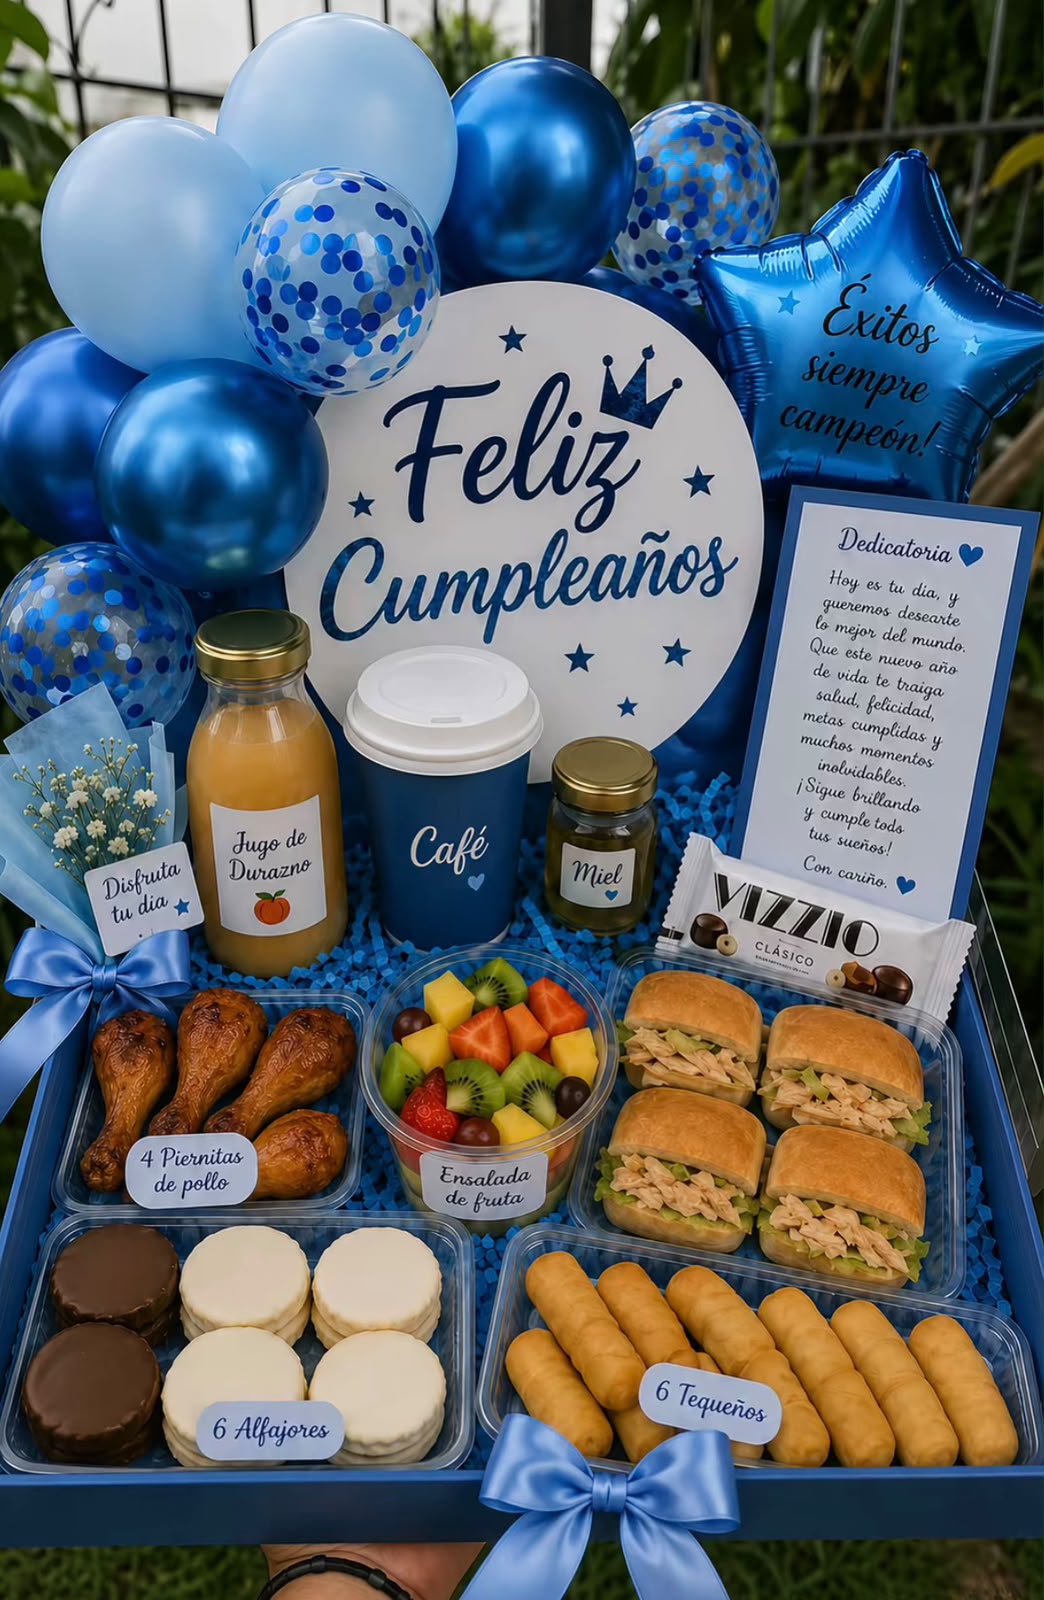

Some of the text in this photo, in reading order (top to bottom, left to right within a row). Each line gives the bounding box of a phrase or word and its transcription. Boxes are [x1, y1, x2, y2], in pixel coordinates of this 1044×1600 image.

[823, 273, 940, 354] Éxitos
[801, 351, 930, 410] siempre
[780, 404, 942, 457] campeón!
[382, 372, 641, 533] Feliz
[838, 526, 952, 563] Dedicatoria
[319, 528, 739, 644] Cumpleaños
[829, 569, 860, 594] Hoy
[866, 580, 882, 591] es
[889, 580, 905, 594] tu
[948, 592, 960, 609] y
[897, 604, 961, 627] desearte
[815, 614, 966, 653] lo mejor del mundo.
[809, 636, 958, 675] Que este nuevo año
[813, 663, 945, 701] de vida te traiga
[816, 688, 935, 722] salud, felicidad,
[803, 711, 943, 751] metas cumplidas y
[800, 734, 935, 769] muchos momentos
[817, 758, 907, 787] inolvidables.
[796, 776, 921, 814] ¡Sigue brillando
[803, 807, 815, 822] y
[820, 811, 872, 831] cumple
[232, 828, 308, 860] Jugo de
[410, 825, 490, 876] Café
[808, 826, 893, 857] tus sueños!
[102, 861, 181, 901] Disfruta
[228, 858, 313, 882] Durazno
[571, 860, 623, 889] Miel
[803, 855, 888, 889] Con cariño.
[111, 905, 133, 924] tu
[714, 872, 880, 957] VIZZIO
[754, 941, 815, 967] CLÁSICO
[140, 1147, 244, 1168] 4 Piernitas
[154, 1171, 229, 1199] de pollo
[440, 1165, 532, 1187] Ensalada
[445, 1190, 524, 1213] de fruta
[655, 1380, 767, 1422] 6 Tequeños
[213, 1416, 329, 1447] 6 Alfajores
